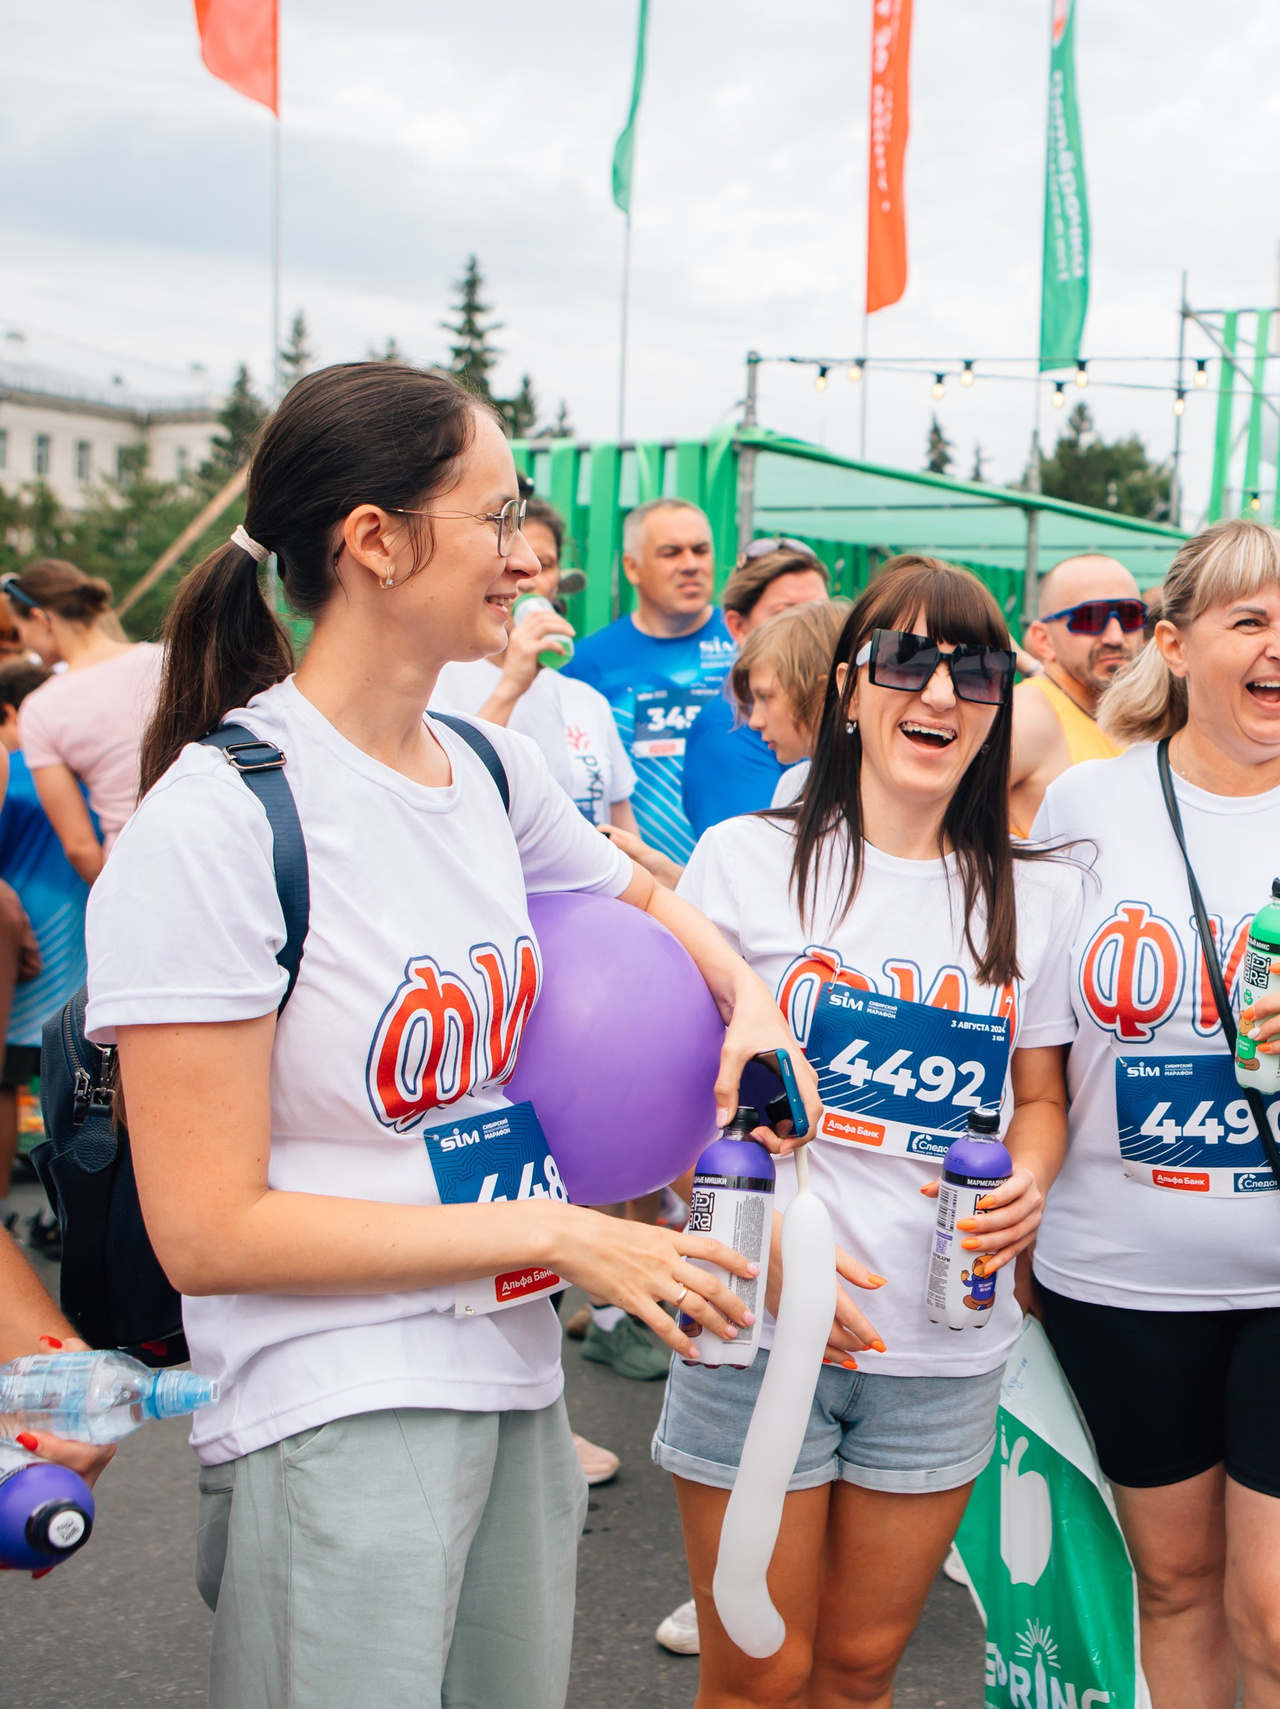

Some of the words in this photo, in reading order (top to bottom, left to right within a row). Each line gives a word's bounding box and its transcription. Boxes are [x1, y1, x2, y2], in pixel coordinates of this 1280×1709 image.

[868, 1000, 898, 1011] СИБИРСКИЙ
[866, 1008, 897, 1019] МАРАФОН
[950, 1020, 957, 1028] 3
[957, 1022, 990, 1032] АВГУСТА
[990, 1024, 1006, 1034] 2024
[829, 1039, 986, 1107] 4492
[482, 1117, 509, 1131] СИБИРСКИЙ
[827, 1119, 857, 1133] Альфа
[857, 1126, 880, 1139] Банк
[484, 1127, 511, 1140] МАРАФОН
[704, 1176, 727, 1186] МИШКИ
[1157, 1174, 1184, 1185] Альфа
[1184, 1177, 1206, 1186] Банк
[501, 1275, 533, 1293] Альфа
